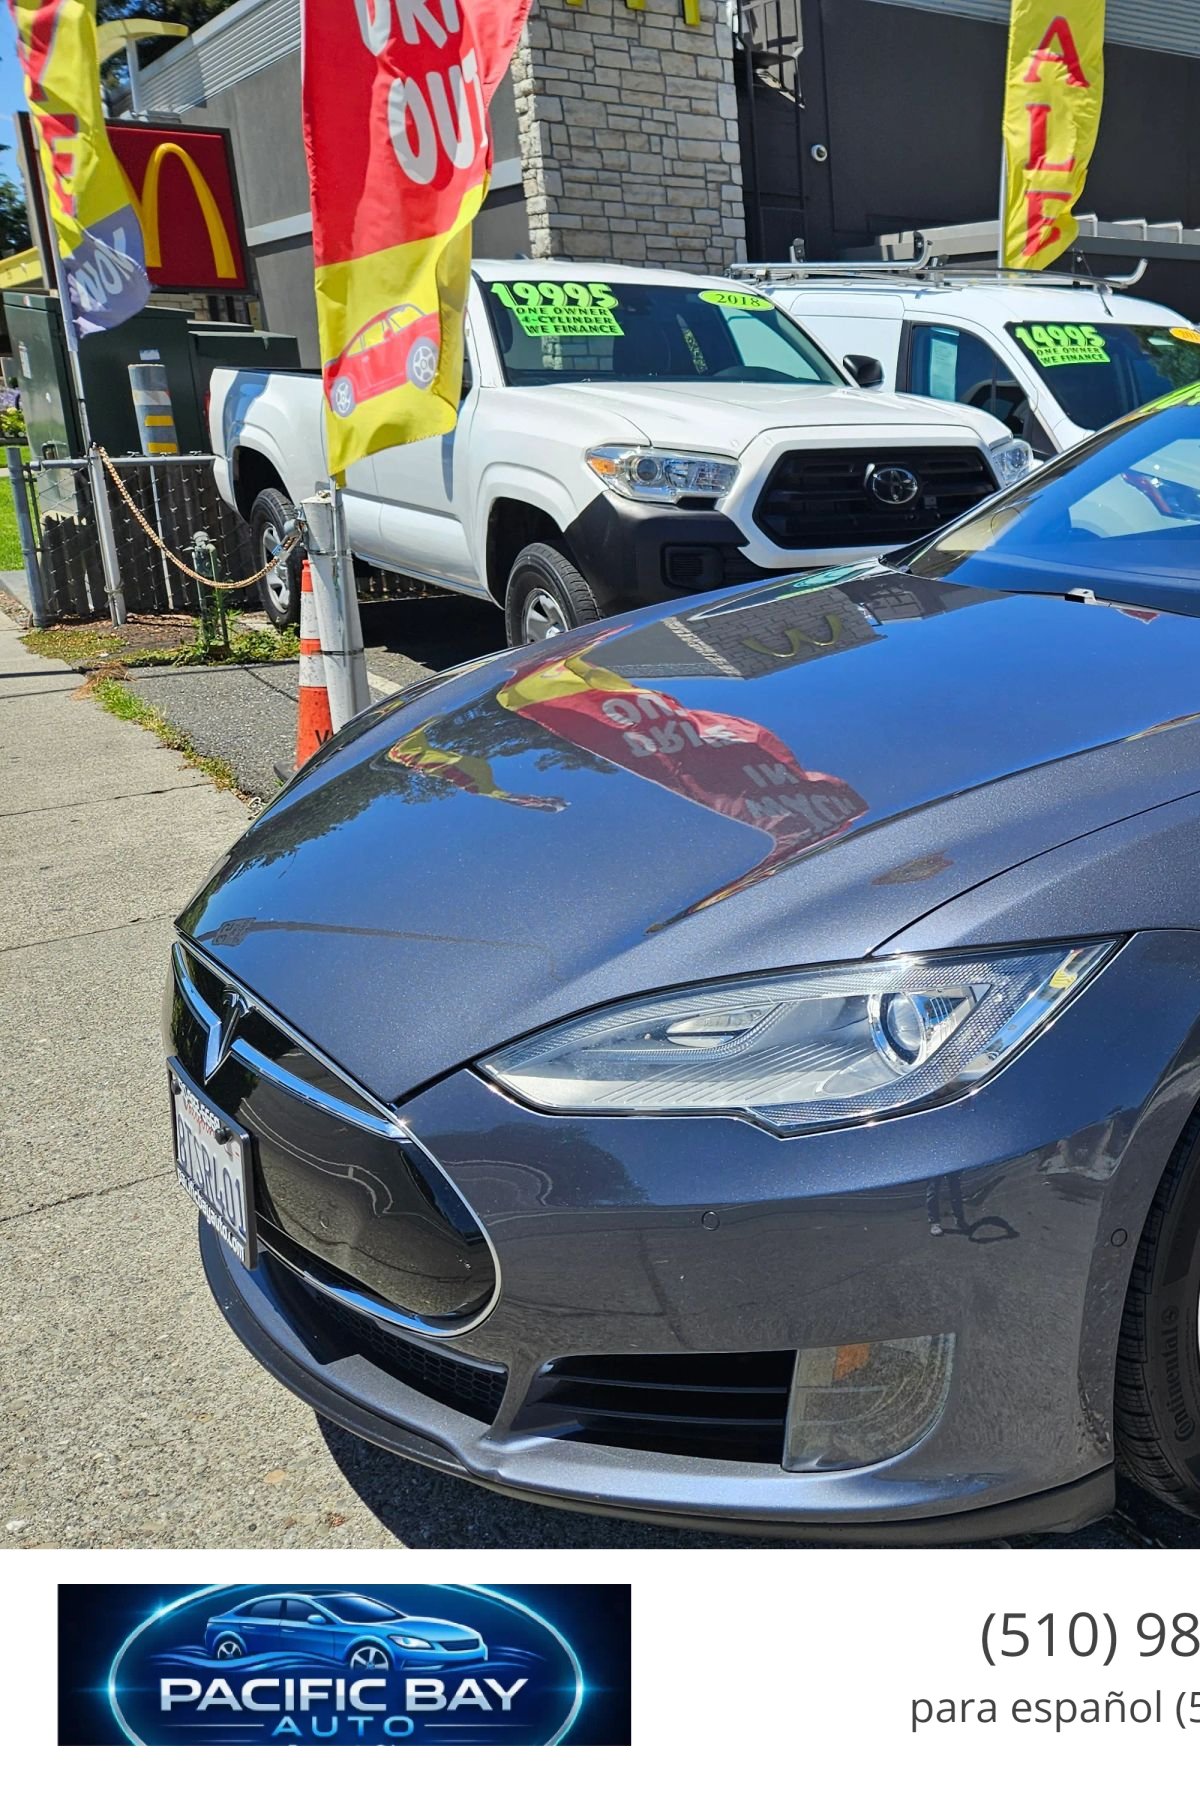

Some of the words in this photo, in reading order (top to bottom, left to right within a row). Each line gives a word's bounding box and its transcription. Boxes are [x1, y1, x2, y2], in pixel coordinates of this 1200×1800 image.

[387, 48, 489, 185] OUT
[491, 282, 618, 310] 19995
[715, 293, 761, 307] 2018
[516, 307, 548, 315] ONE
[554, 307, 608, 316] OWNER
[522, 315, 613, 324] 4-CYLINDER
[525, 325, 550, 333] WE
[555, 325, 619, 333] FINANCE
[1015, 325, 1106, 349] 14995
[1037, 347, 1059, 356] ONE
[1041, 355, 1058, 363] WE
[1060, 353, 1105, 361] FINANCE
[1160, 1324, 1196, 1442] Continental
